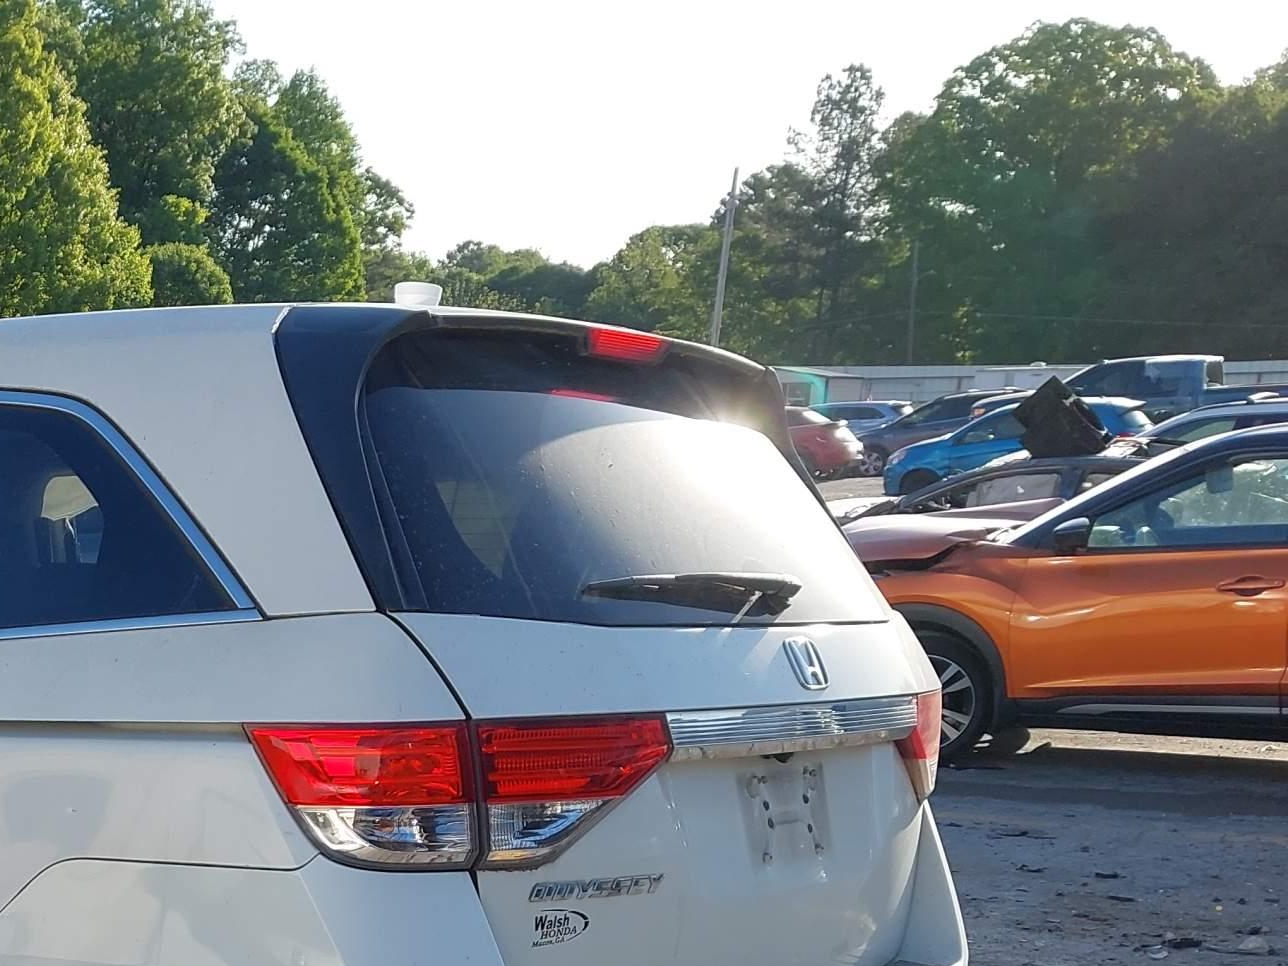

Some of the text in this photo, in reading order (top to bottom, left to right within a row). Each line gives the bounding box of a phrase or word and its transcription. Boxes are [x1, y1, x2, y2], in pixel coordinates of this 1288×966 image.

[528, 873, 664, 902] ODYSSEY
[534, 913, 570, 932] Walsh
[540, 926, 577, 940] HONDA
